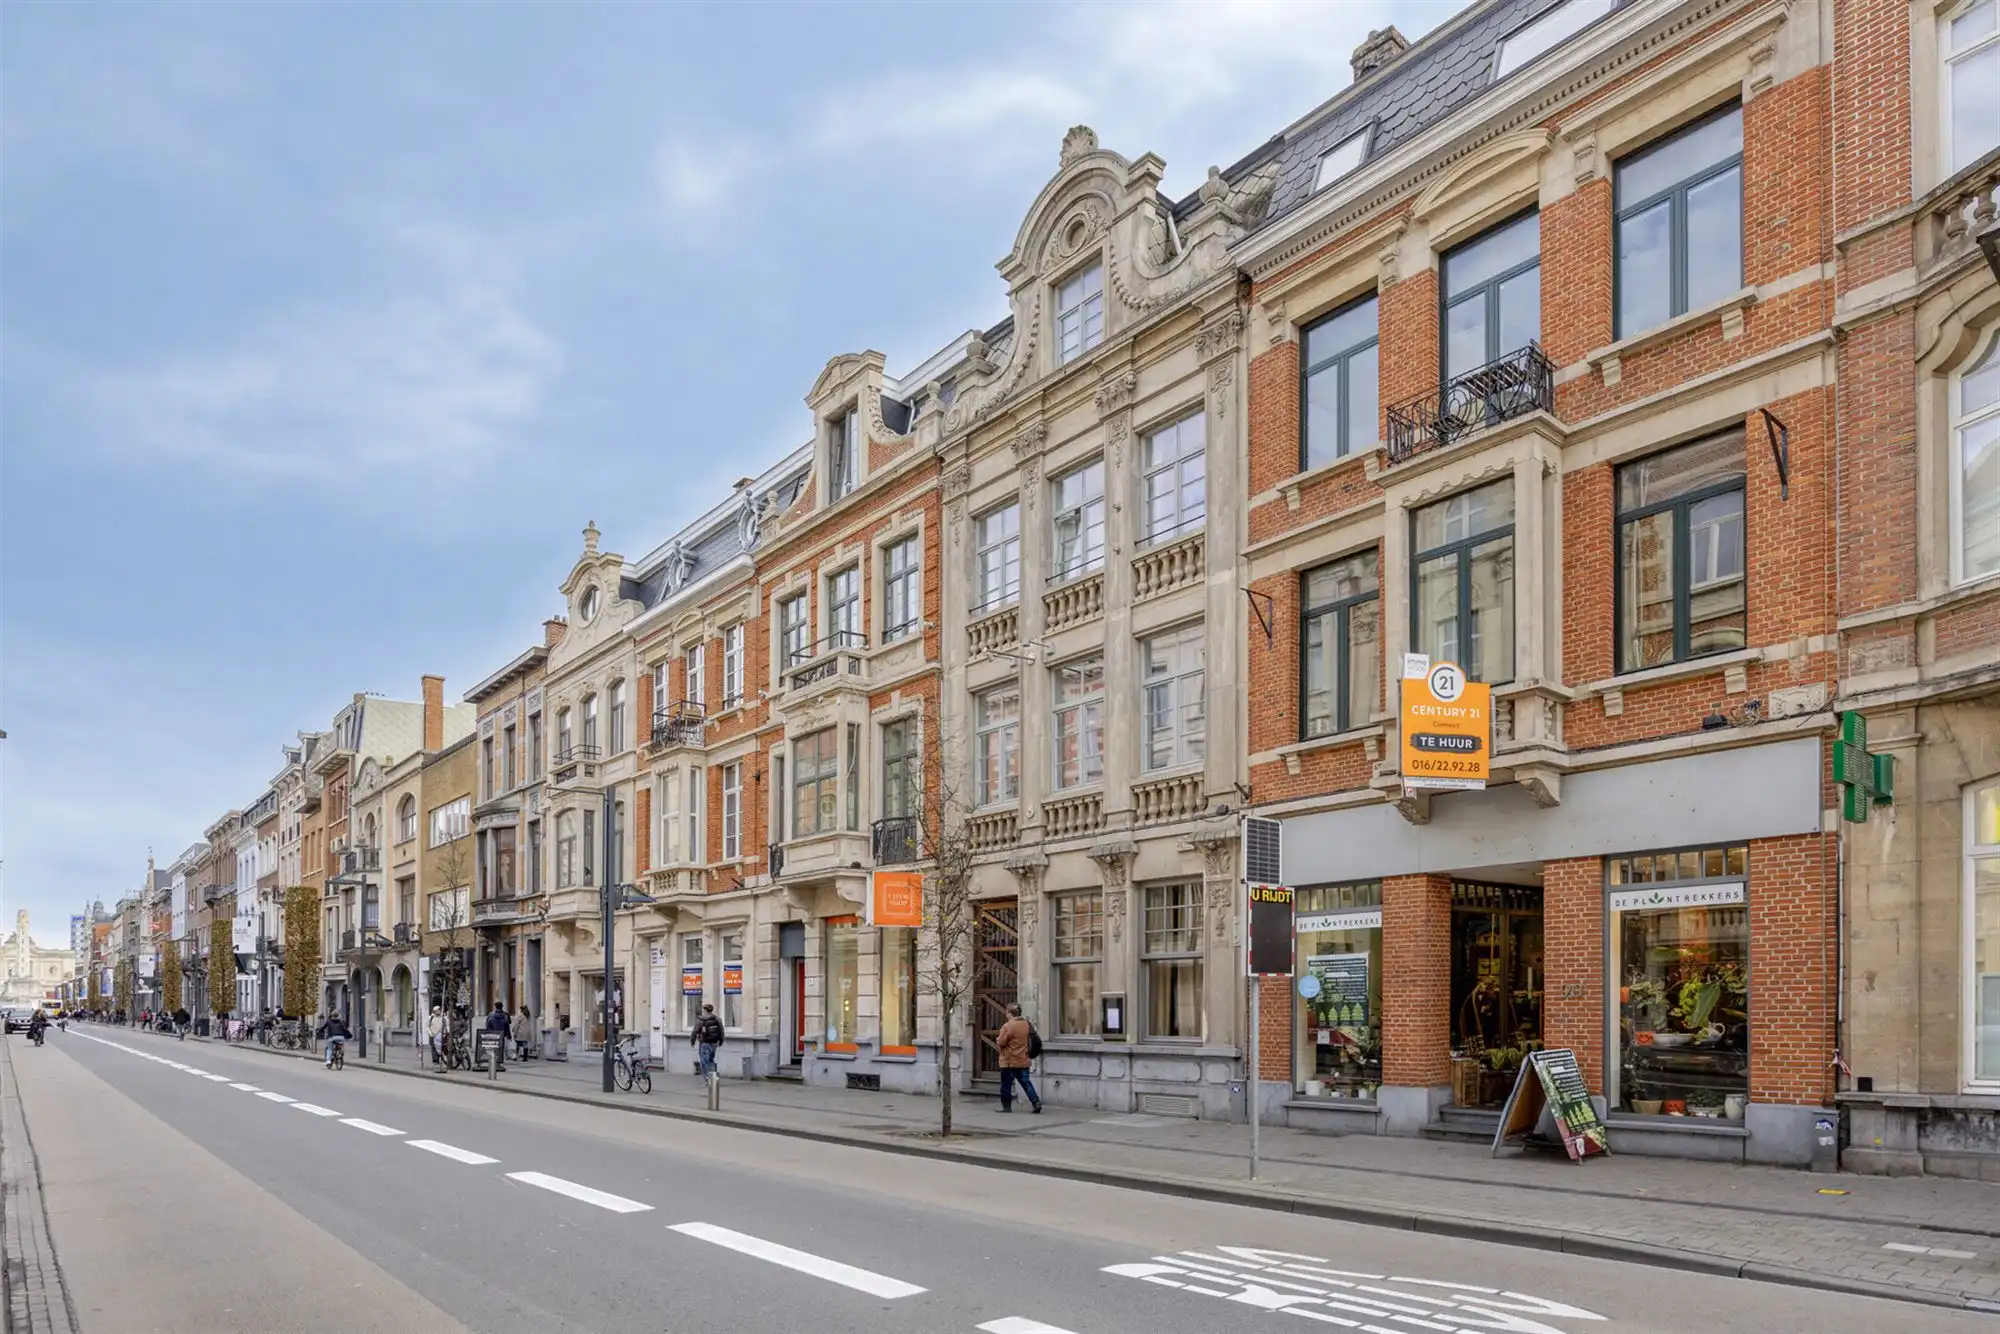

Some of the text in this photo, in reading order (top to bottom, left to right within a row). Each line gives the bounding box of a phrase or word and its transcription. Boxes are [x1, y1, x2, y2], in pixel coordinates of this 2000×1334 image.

[1411, 704, 1481, 718] CENTURY 21
[1420, 736, 1473, 749] TE HUUR
[1411, 759, 1480, 772] 016/22.92.28
[1251, 888, 1292, 903] U RIJDT
